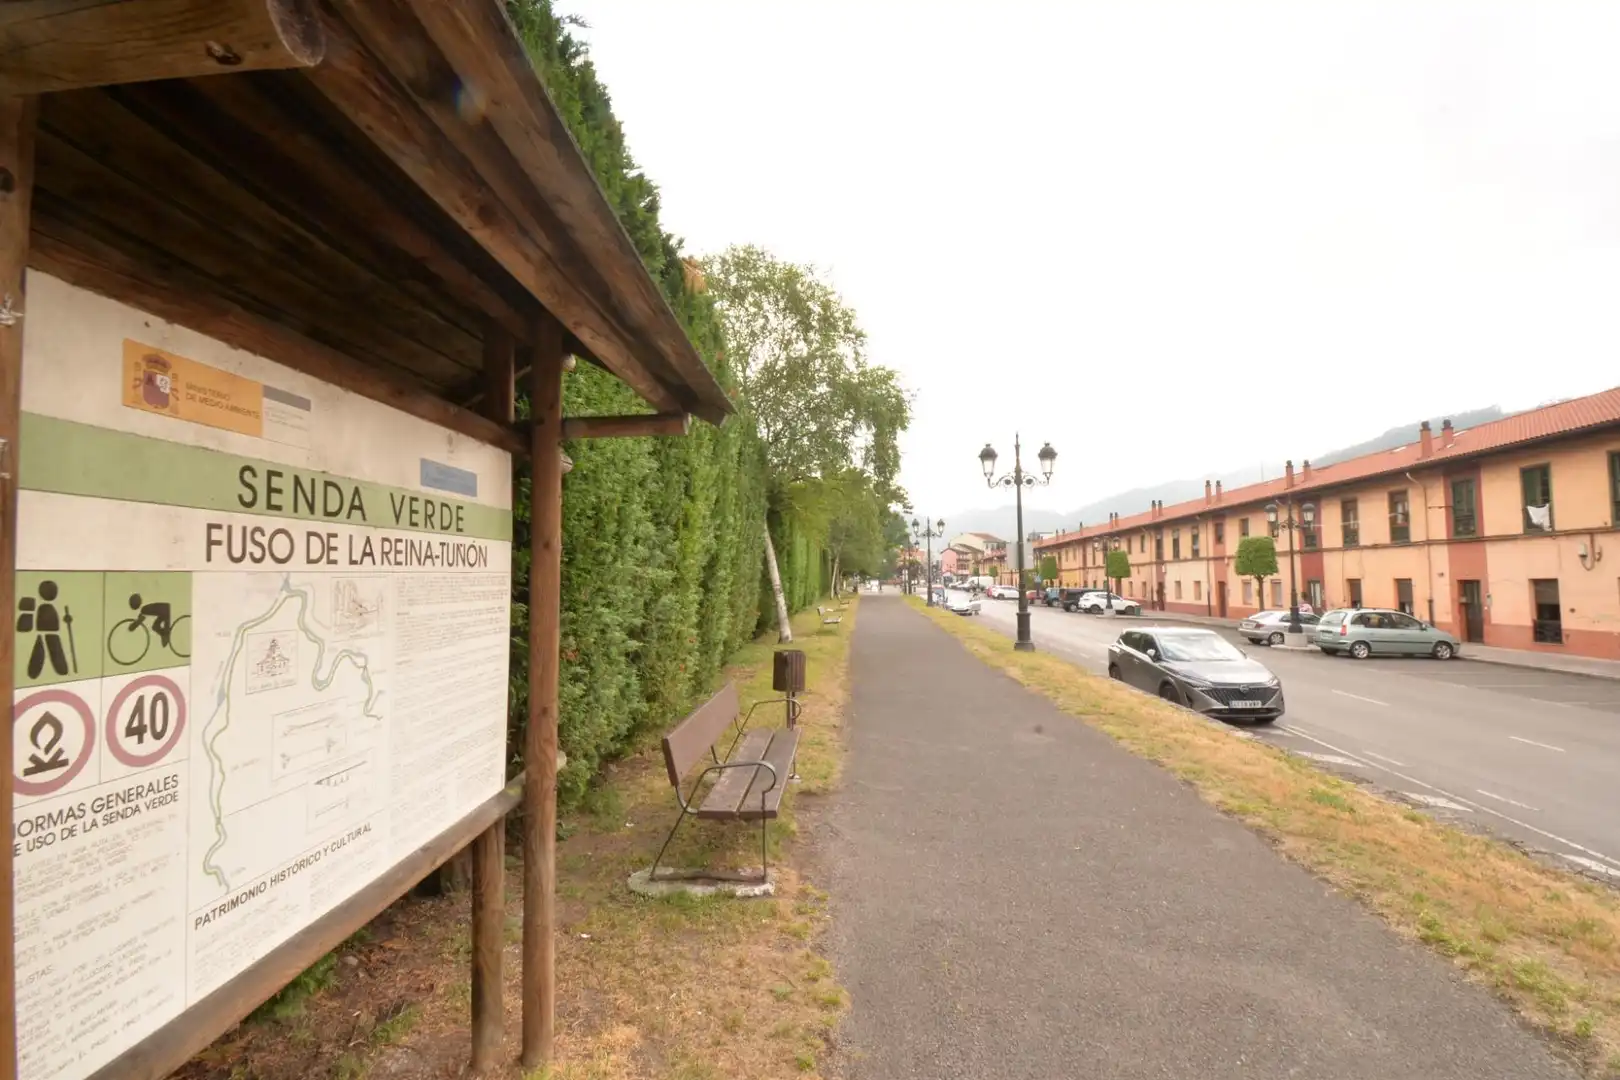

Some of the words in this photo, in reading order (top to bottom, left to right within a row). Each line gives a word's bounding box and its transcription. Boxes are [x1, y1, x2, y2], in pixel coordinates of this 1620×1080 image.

[185, 392, 197, 403] DE
[237, 464, 367, 522] SENDA
[389, 492, 465, 533] VERDE
[205, 522, 295, 565] FUSO
[306, 531, 339, 565] DE
[348, 534, 376, 566] LA
[380, 536, 488, 568] REINA-TUÑÓN
[125, 691, 169, 745] 40
[26, 831, 56, 853] USO
[60, 824, 78, 841] DE
[83, 819, 99, 834] LA
[102, 807, 142, 827] SENDA
[144, 790, 179, 811] VERDE
[91, 774, 179, 815] GENERALES
[194, 881, 267, 931] PATRIMONIO
[269, 850, 322, 888] HISTÓRICO
[322, 846, 330, 858] Y
[330, 821, 373, 854] CULTURAL
